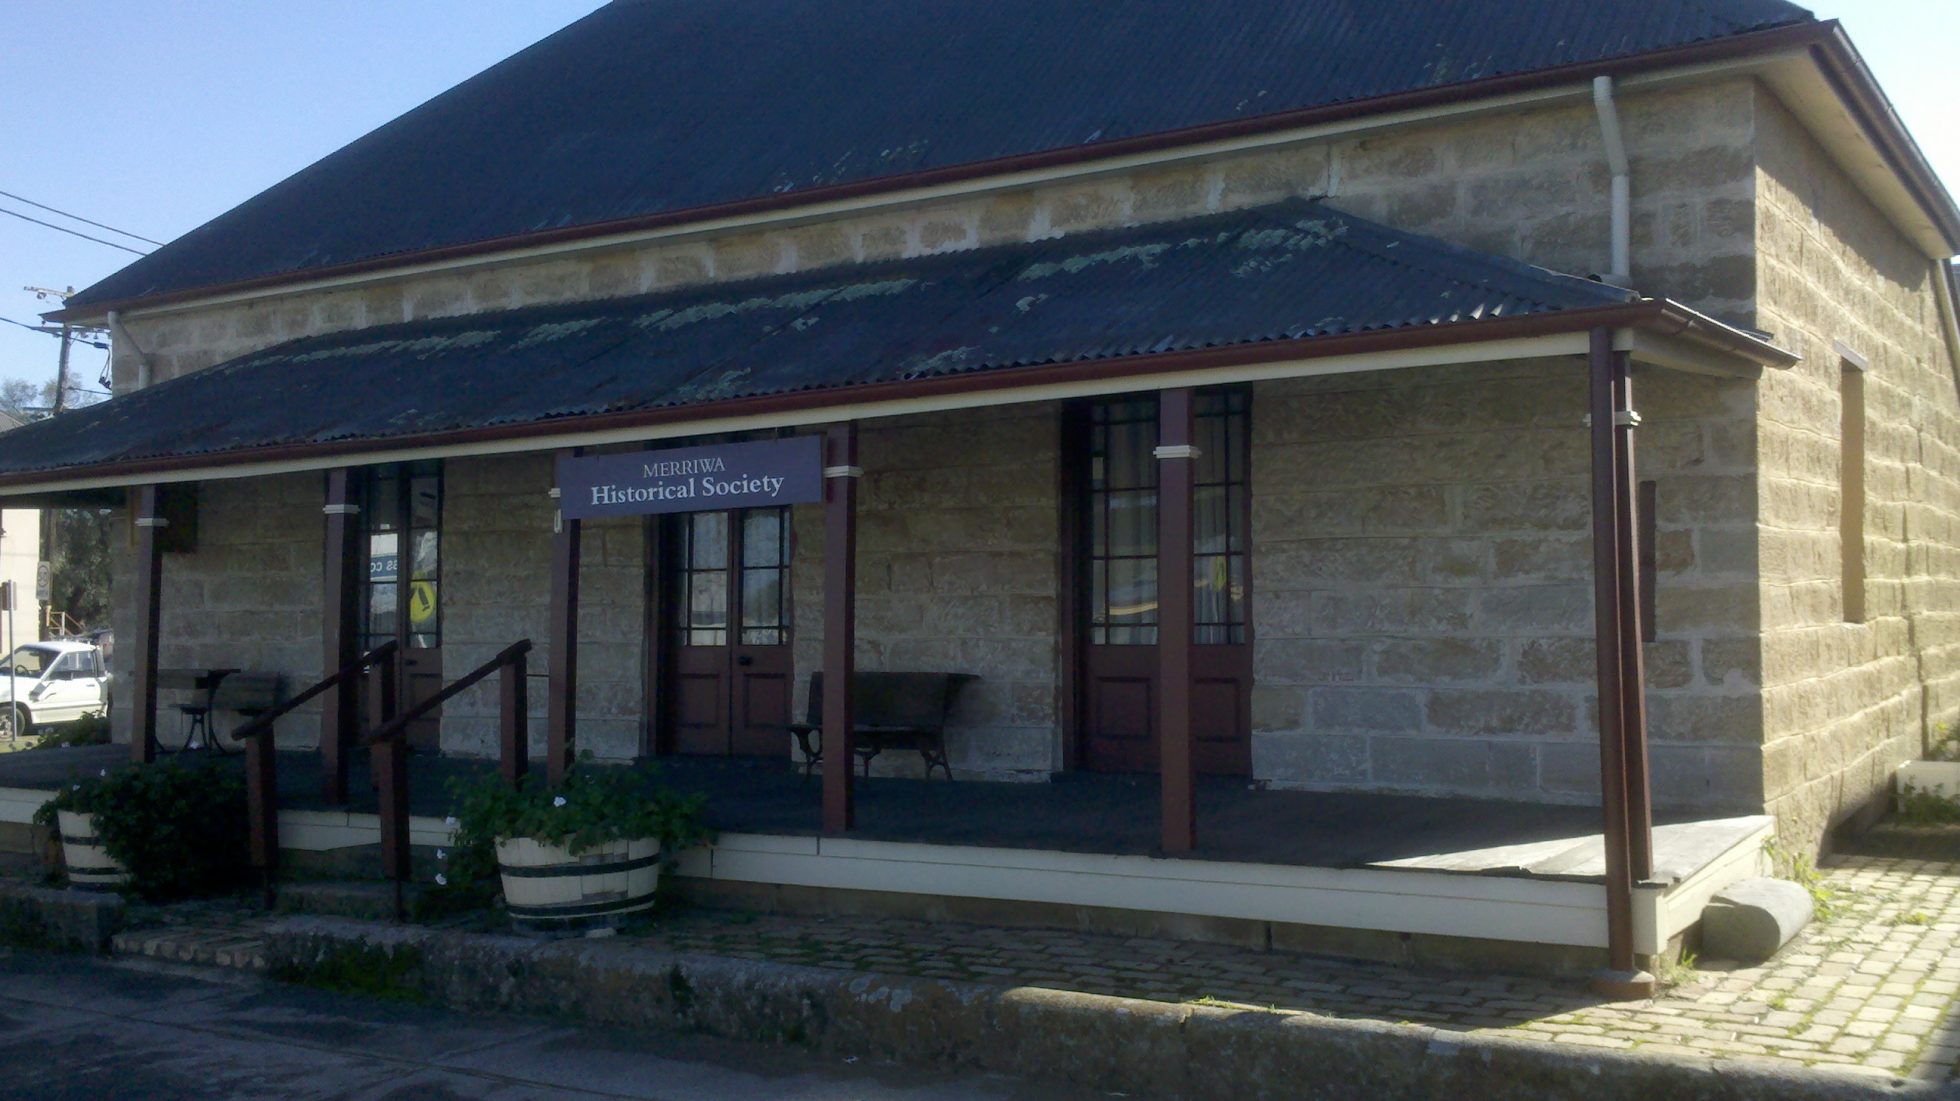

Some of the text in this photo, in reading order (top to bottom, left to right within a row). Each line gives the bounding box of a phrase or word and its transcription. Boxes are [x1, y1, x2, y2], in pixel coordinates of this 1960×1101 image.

[642, 457, 726, 478] MERRIWA
[591, 473, 784, 505] Historical Society
